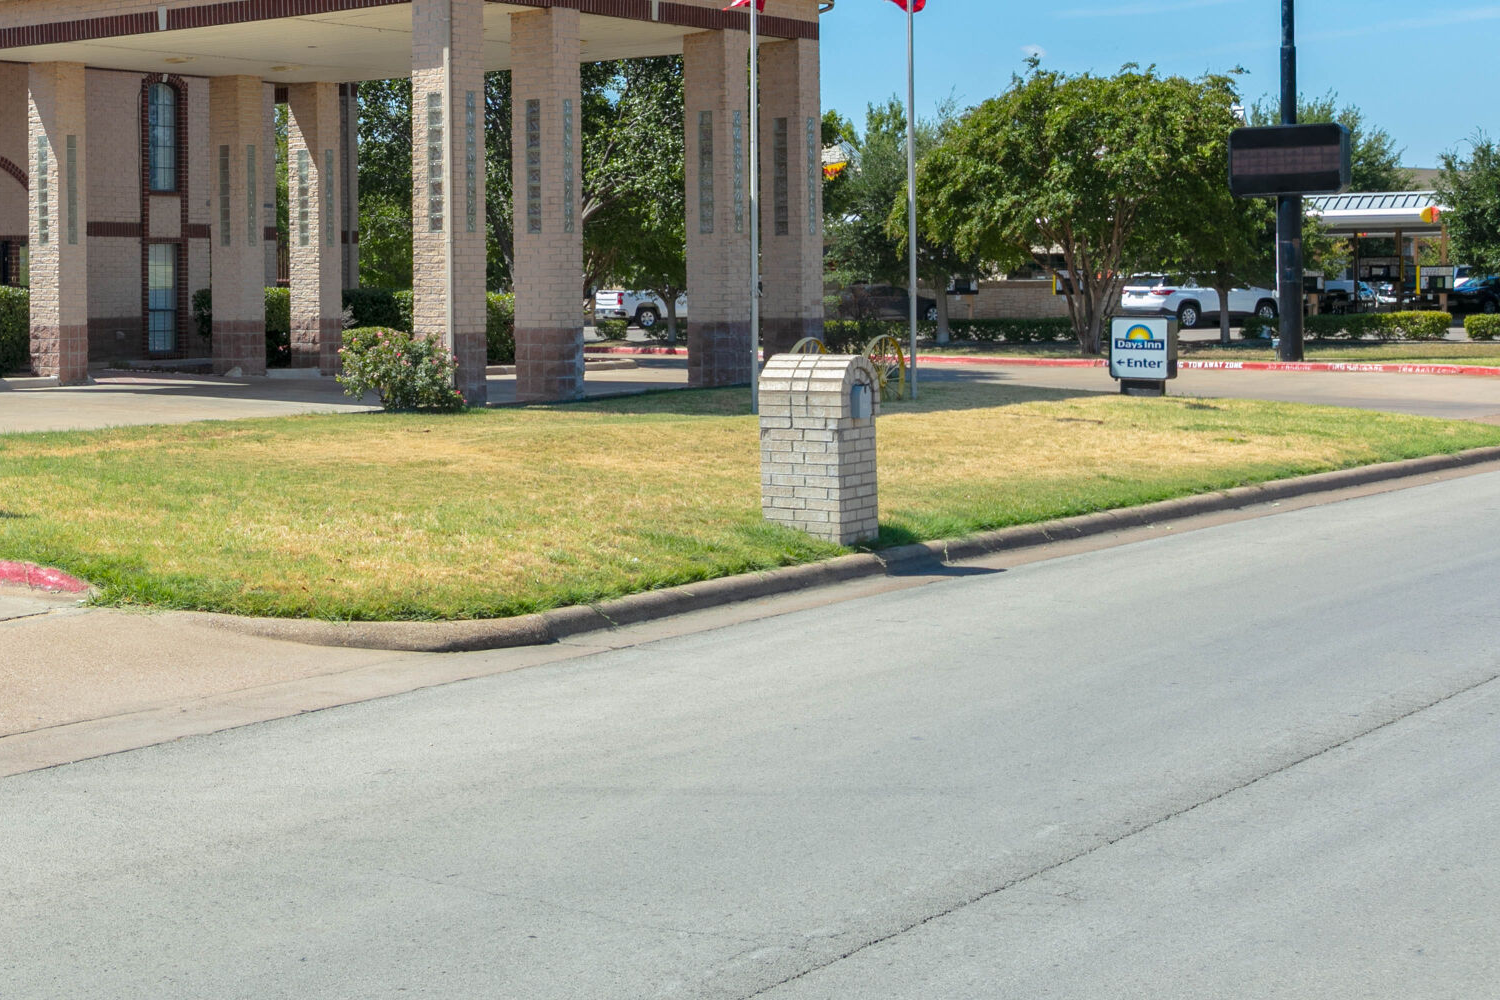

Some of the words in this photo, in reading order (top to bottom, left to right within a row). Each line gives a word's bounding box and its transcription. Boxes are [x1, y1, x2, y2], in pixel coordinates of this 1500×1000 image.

[1118, 340, 1143, 349] Days
[1144, 341, 1162, 349] Inn
[1127, 358, 1163, 368] Enter
[1188, 361, 1203, 369] TOW
[1203, 361, 1224, 369] AWAY
[1224, 361, 1244, 369] ZONE
